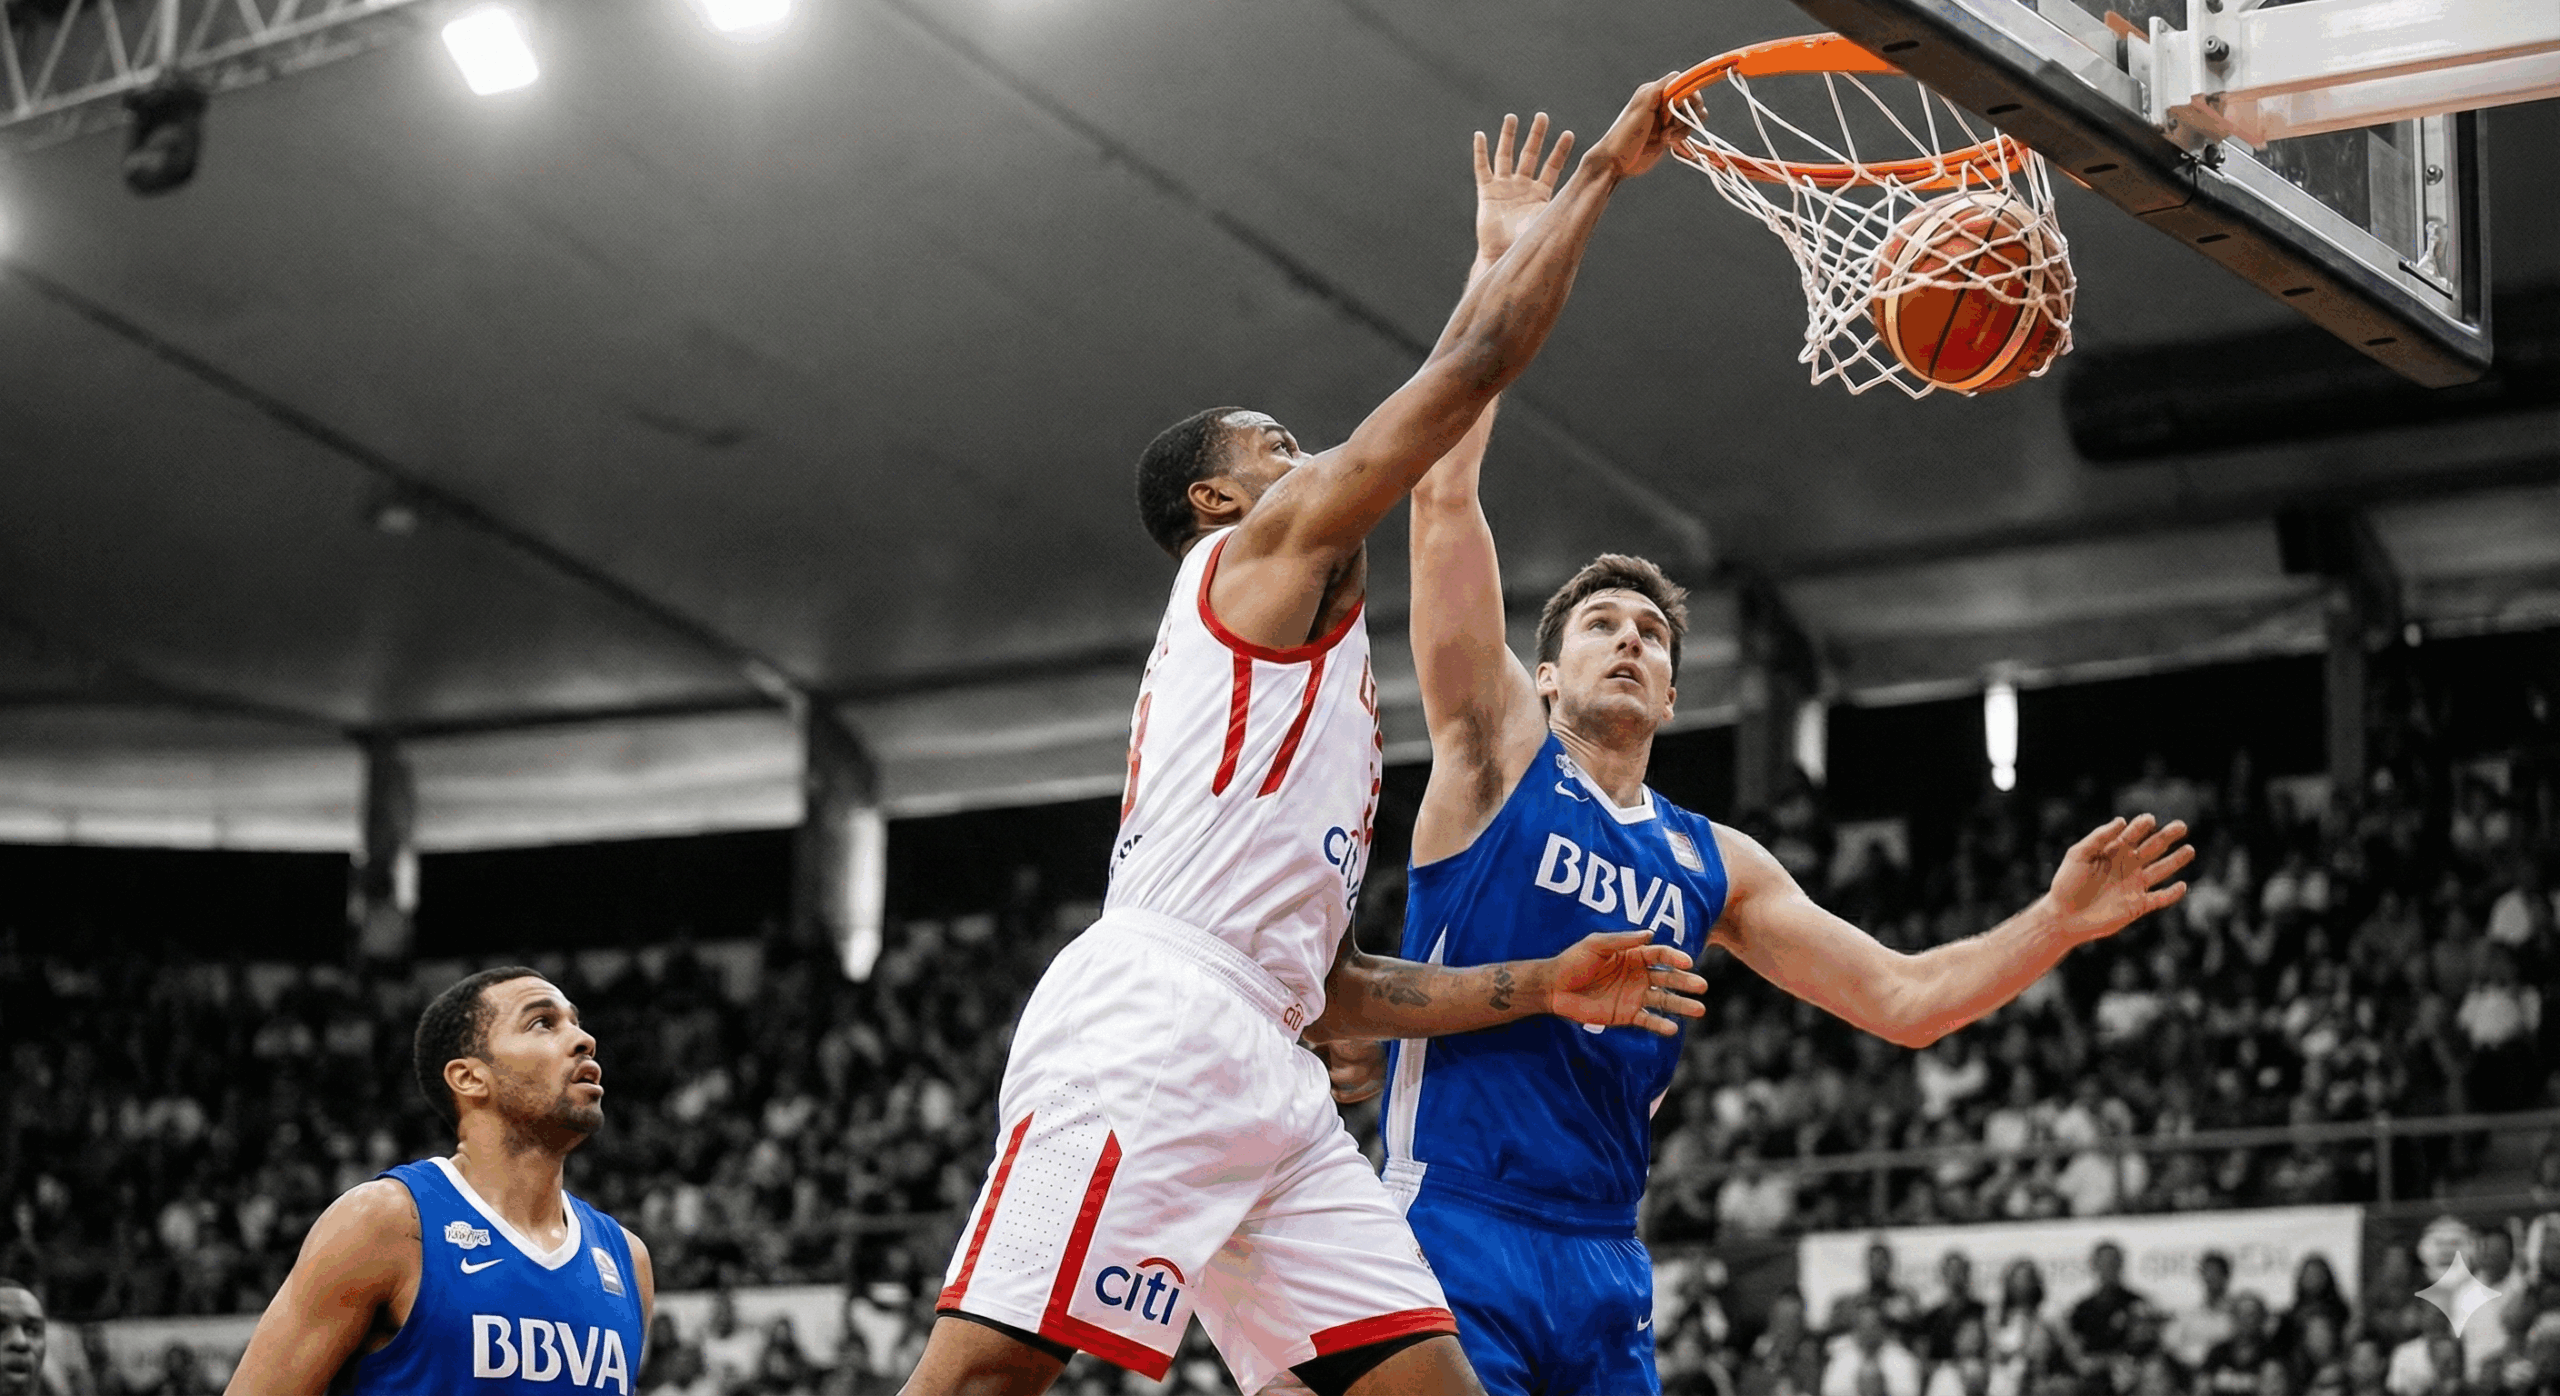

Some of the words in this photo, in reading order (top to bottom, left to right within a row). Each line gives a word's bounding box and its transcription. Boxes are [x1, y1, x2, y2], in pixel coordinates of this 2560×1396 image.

[1535, 832, 1685, 946] BBVA
[1095, 1264, 1180, 1326] citi
[472, 1314, 628, 1396] BBVA
